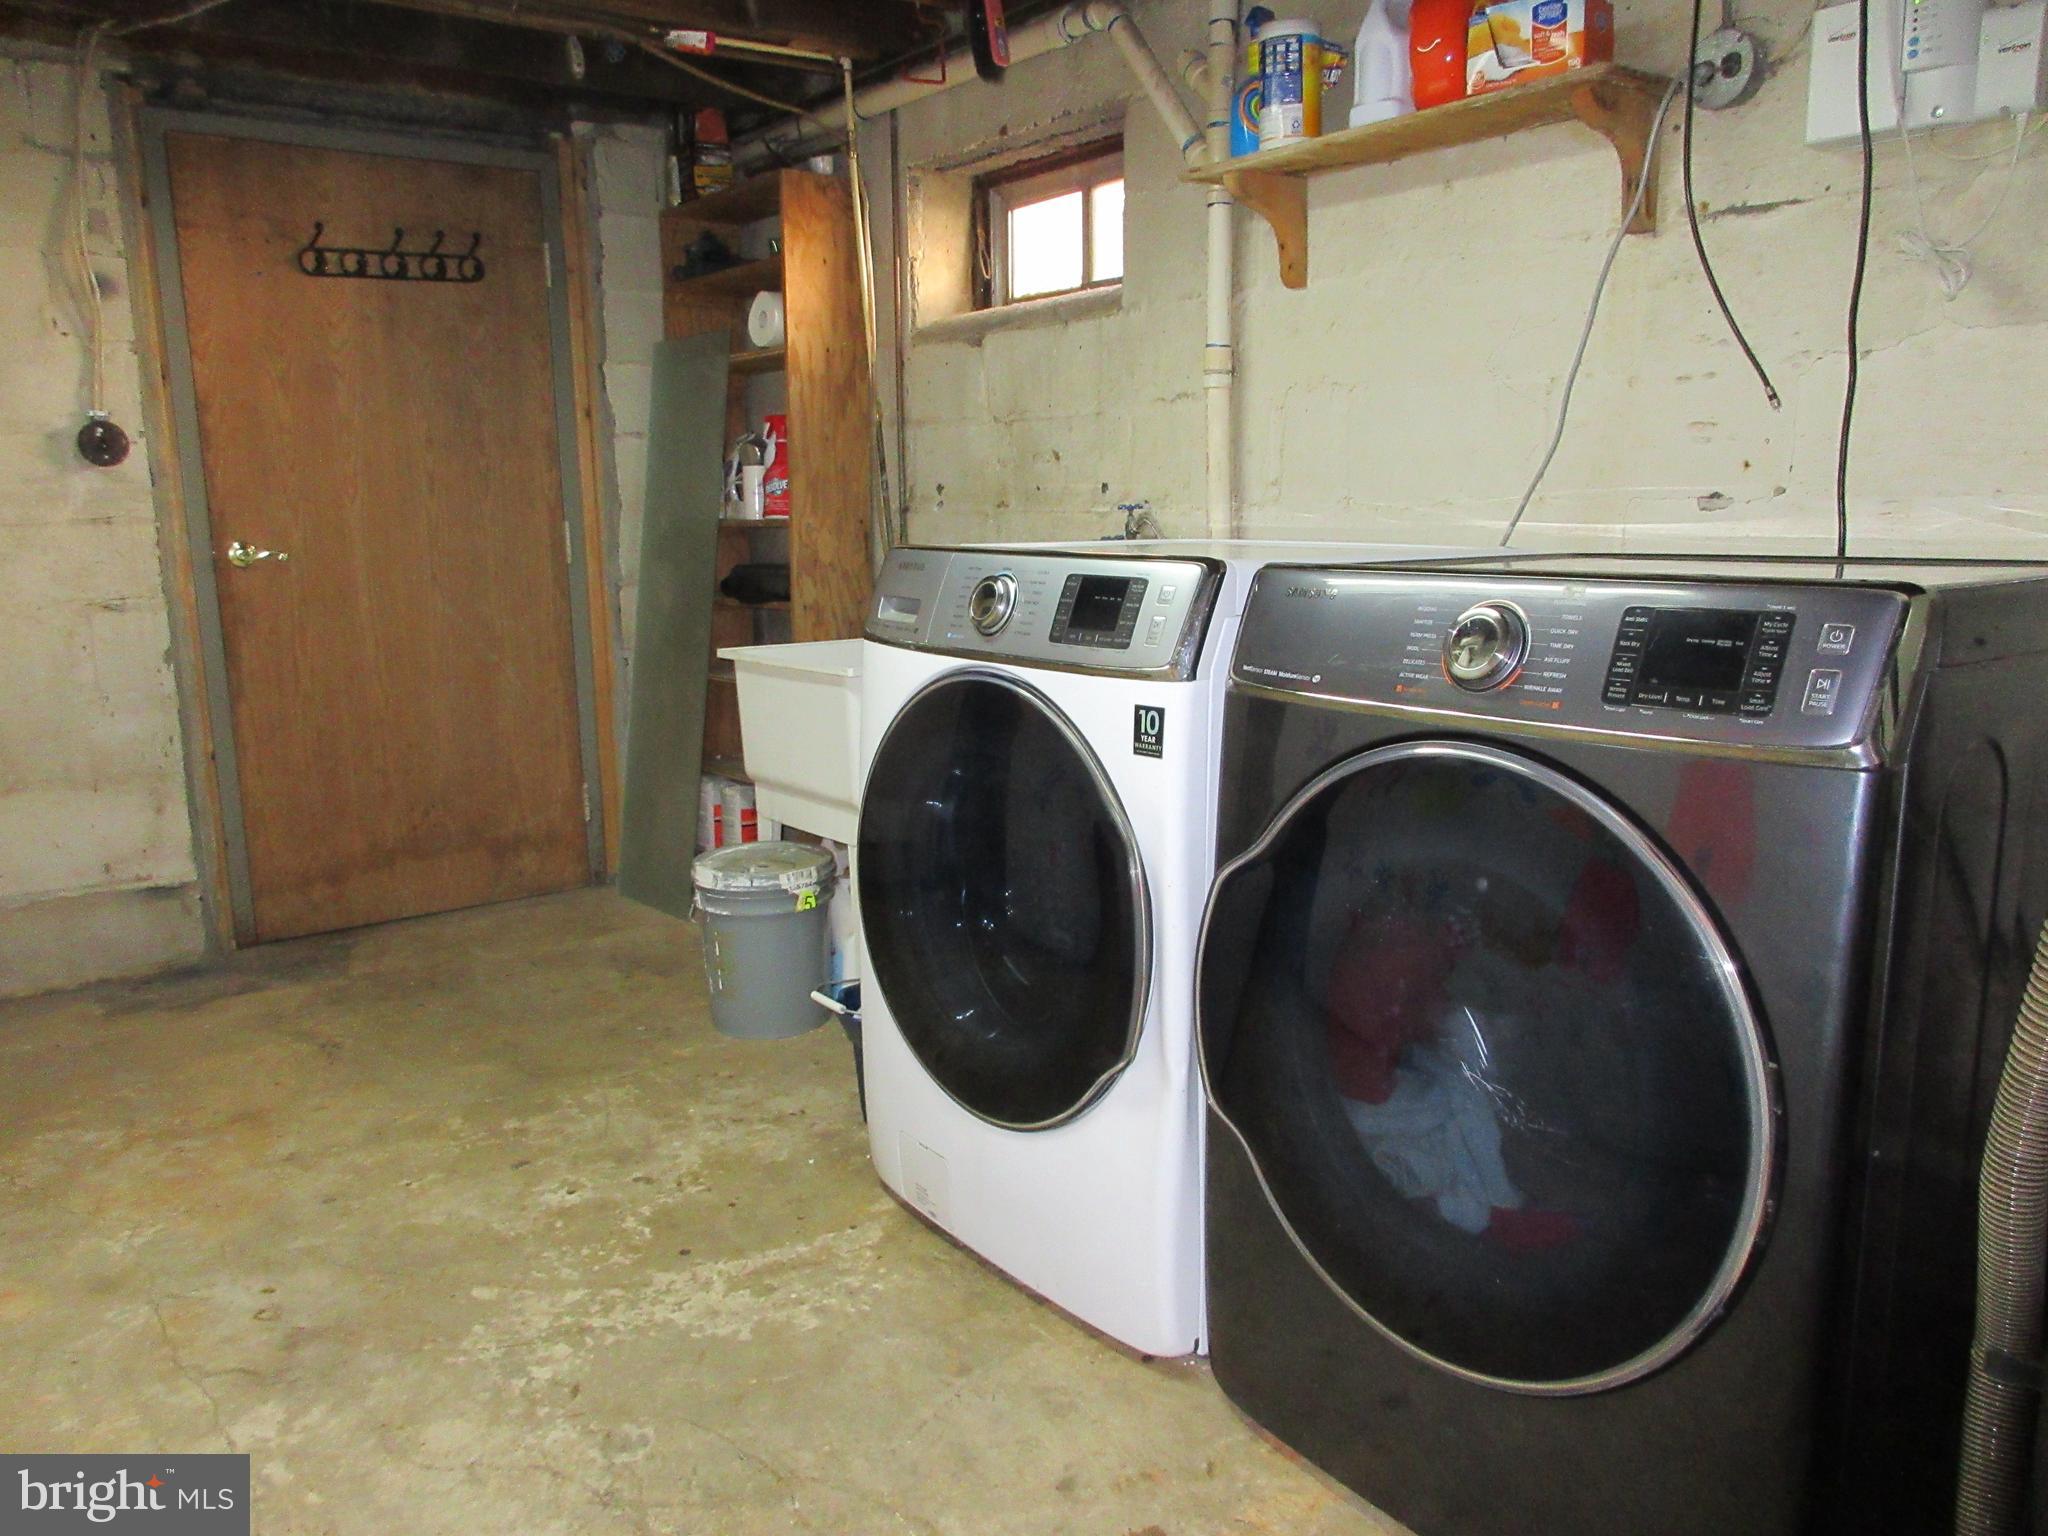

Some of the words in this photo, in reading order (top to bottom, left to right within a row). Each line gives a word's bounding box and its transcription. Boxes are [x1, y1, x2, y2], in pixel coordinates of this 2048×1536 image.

[1138, 709, 1160, 735] 10
[1140, 734, 1156, 744] YEAR
[1134, 743, 1163, 751] WARRANTY
